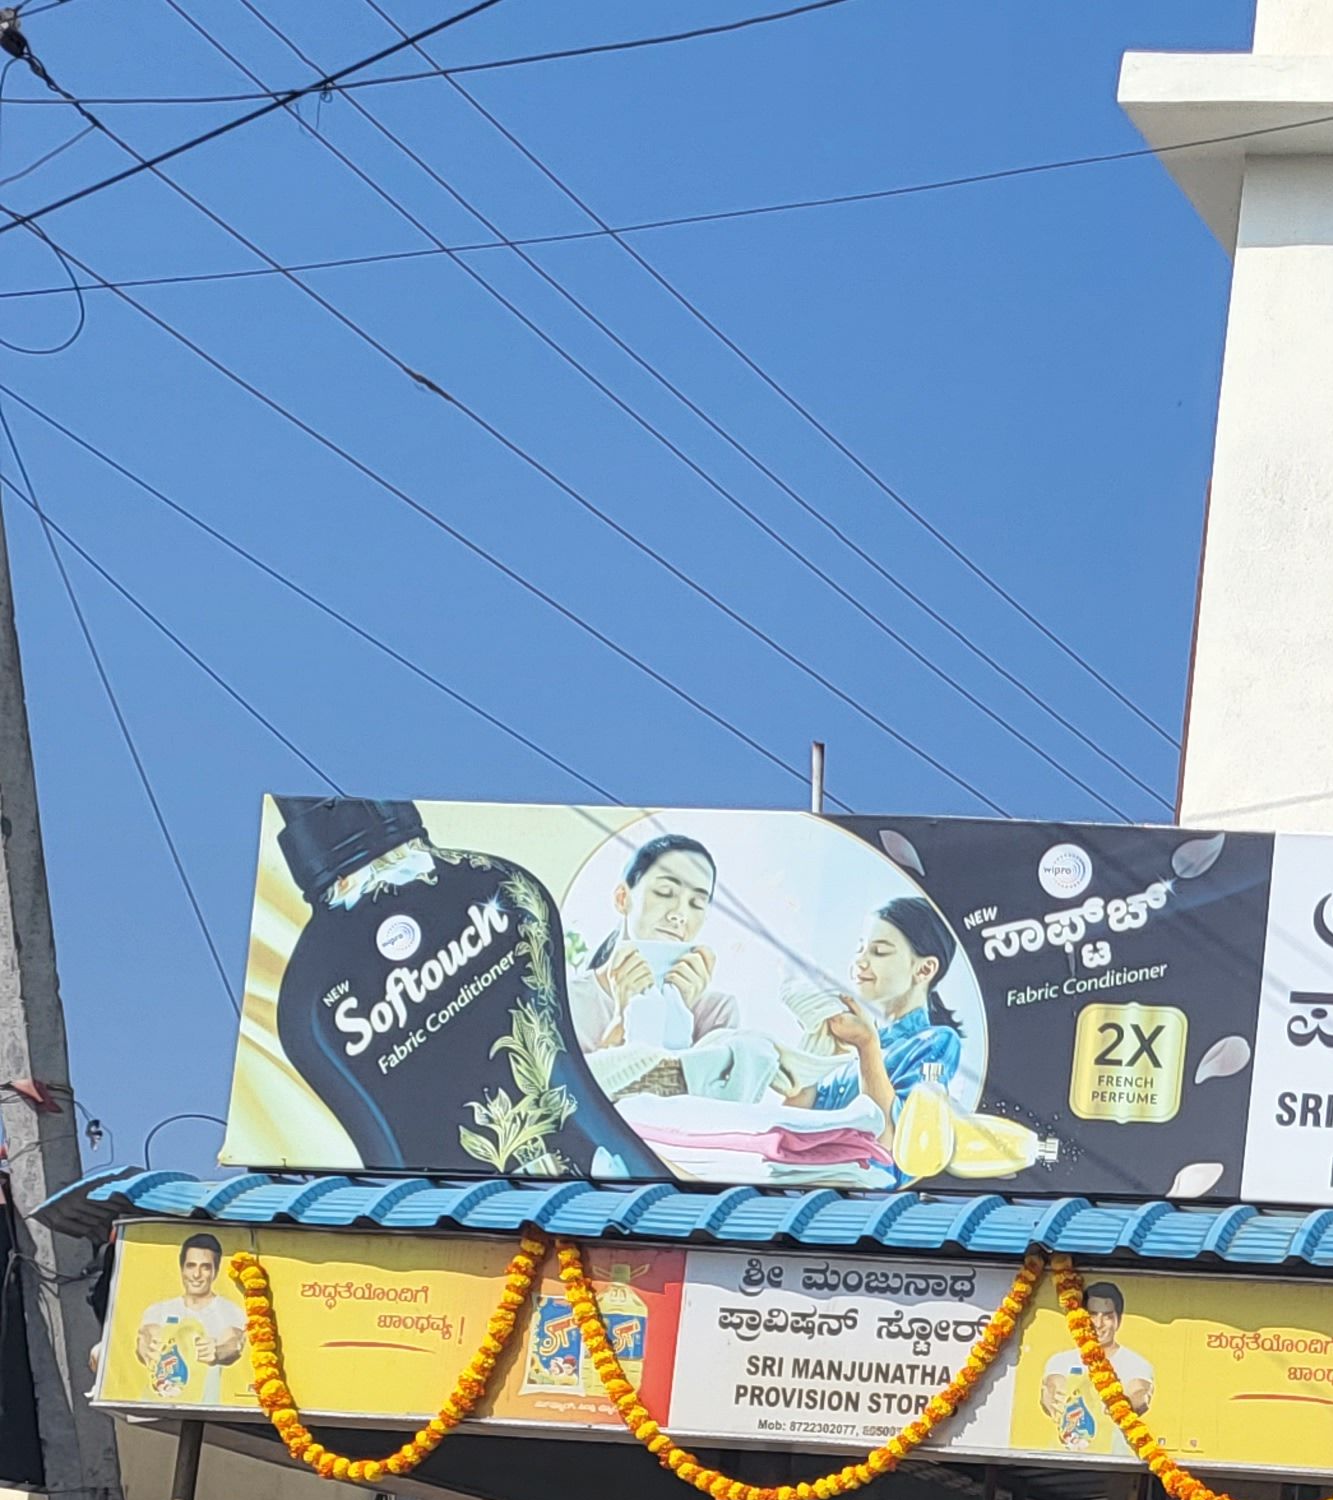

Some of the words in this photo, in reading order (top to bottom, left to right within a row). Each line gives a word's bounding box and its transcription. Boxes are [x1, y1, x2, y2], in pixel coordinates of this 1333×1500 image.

[1043, 865, 1072, 877] wipro
[963, 906, 998, 930] NEW
[322, 980, 350, 1007] NEW
[335, 904, 509, 1056] Softouch
[1007, 983, 1059, 1007] Fabric
[1063, 963, 1168, 995] Conditioner
[378, 1029, 427, 1075] Fabric
[425, 950, 516, 1032] Conditioner
[1094, 1022, 1166, 1069] 2X
[1091, 1091, 1158, 1105] PERFUME
[1097, 1075, 1154, 1089] FRENCH
[738, 1257, 784, 1297] ಶ್ರೀ
[801, 1261, 977, 1302] ಮಂಜುನಾಥ
[717, 1305, 859, 1342] ಪ್ರಾವಿಷನ್
[746, 1355, 783, 1378] SRI
[791, 1358, 951, 1386] MANJUNATHA
[734, 1384, 861, 1412] PROVISION
[867, 1391, 958, 1418] STOR
[758, 1419, 787, 1432] Mob:
